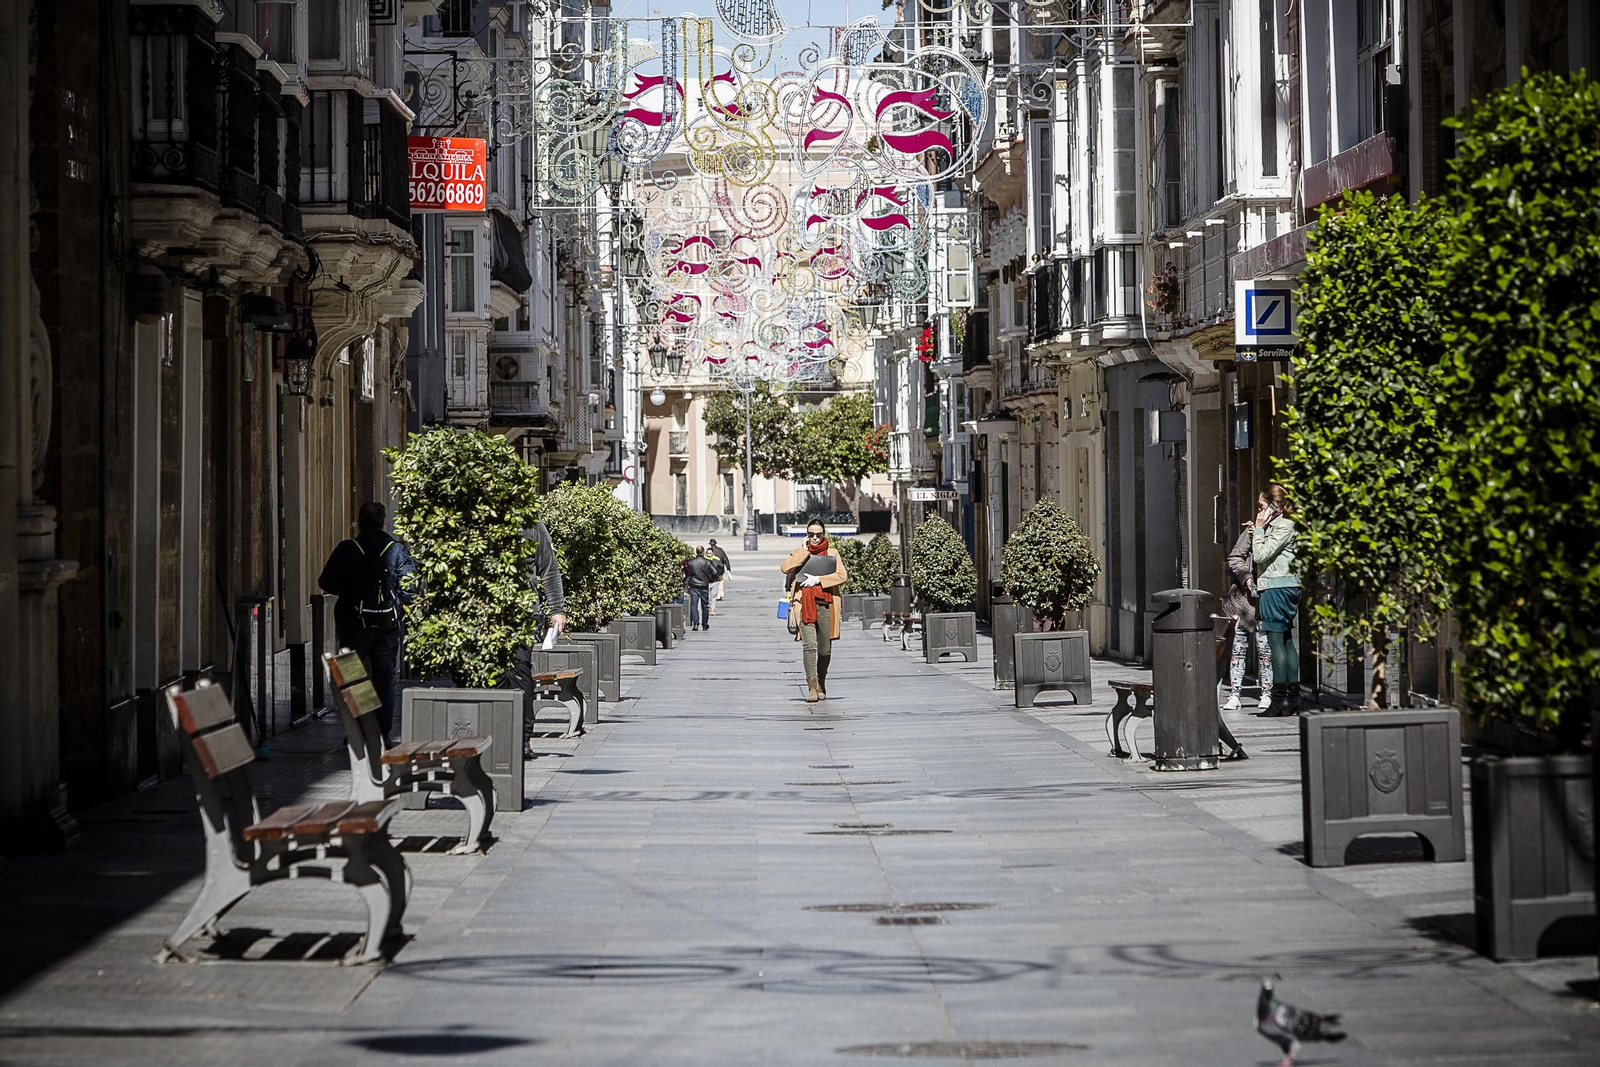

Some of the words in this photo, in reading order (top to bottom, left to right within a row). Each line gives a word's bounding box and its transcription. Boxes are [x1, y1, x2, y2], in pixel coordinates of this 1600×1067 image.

[408, 162, 485, 181] LQUILA
[1258, 348, 1294, 357] ServiRed
[930, 491, 958, 499] SIGLO
